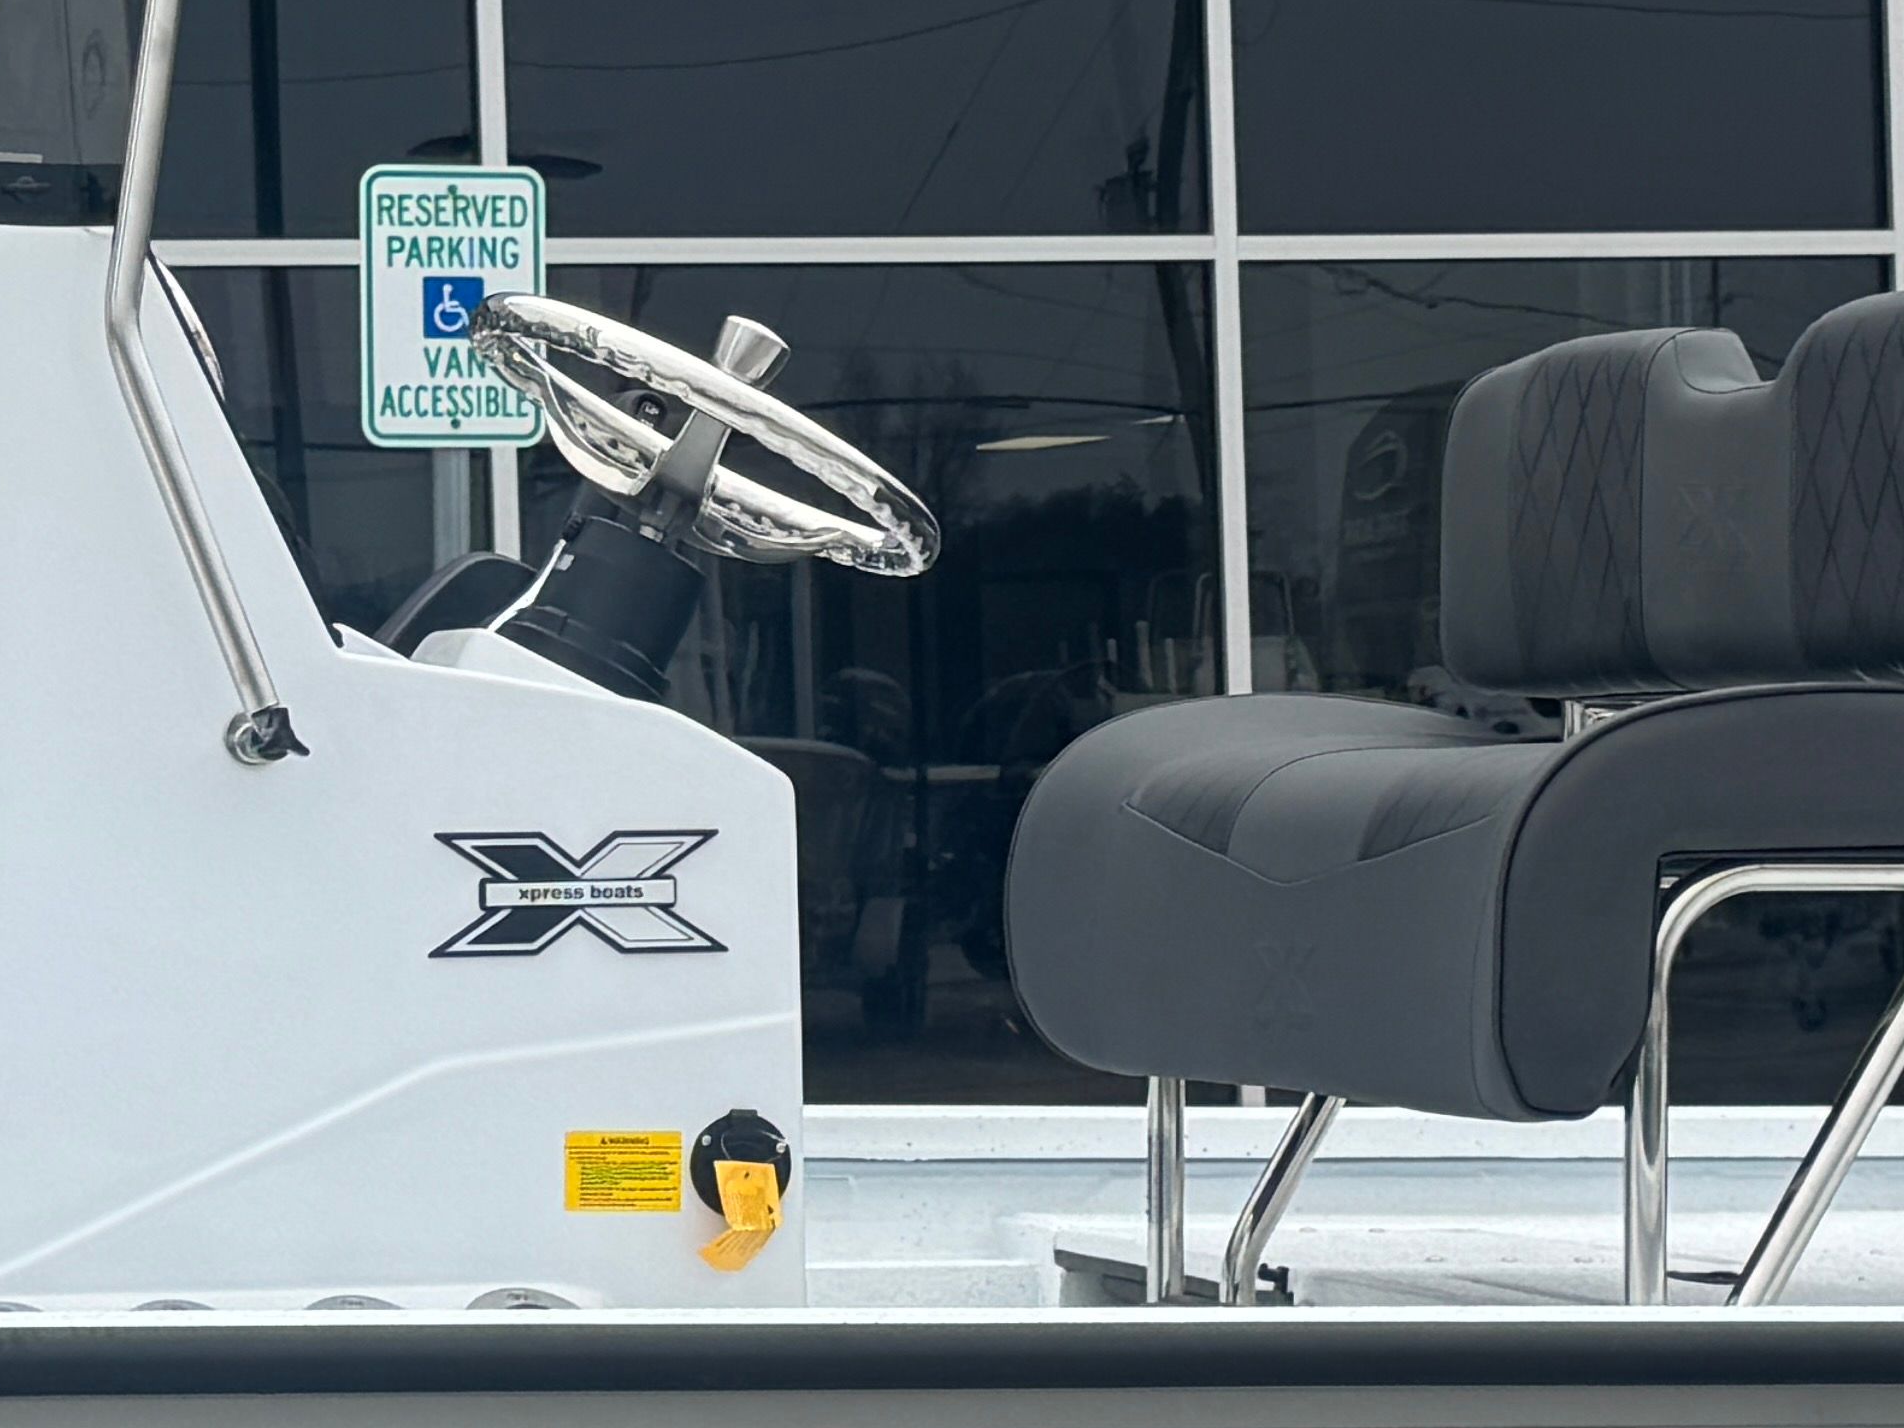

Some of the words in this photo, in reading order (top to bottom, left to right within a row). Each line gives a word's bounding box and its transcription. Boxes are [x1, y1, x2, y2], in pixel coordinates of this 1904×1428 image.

[376, 193, 529, 228] RESERVED
[386, 235, 520, 270] PARKING
[423, 346, 487, 379] VAN
[379, 384, 529, 418] ACCESSIBLE
[518, 886, 585, 903] xpress
[589, 884, 644, 900] boats
